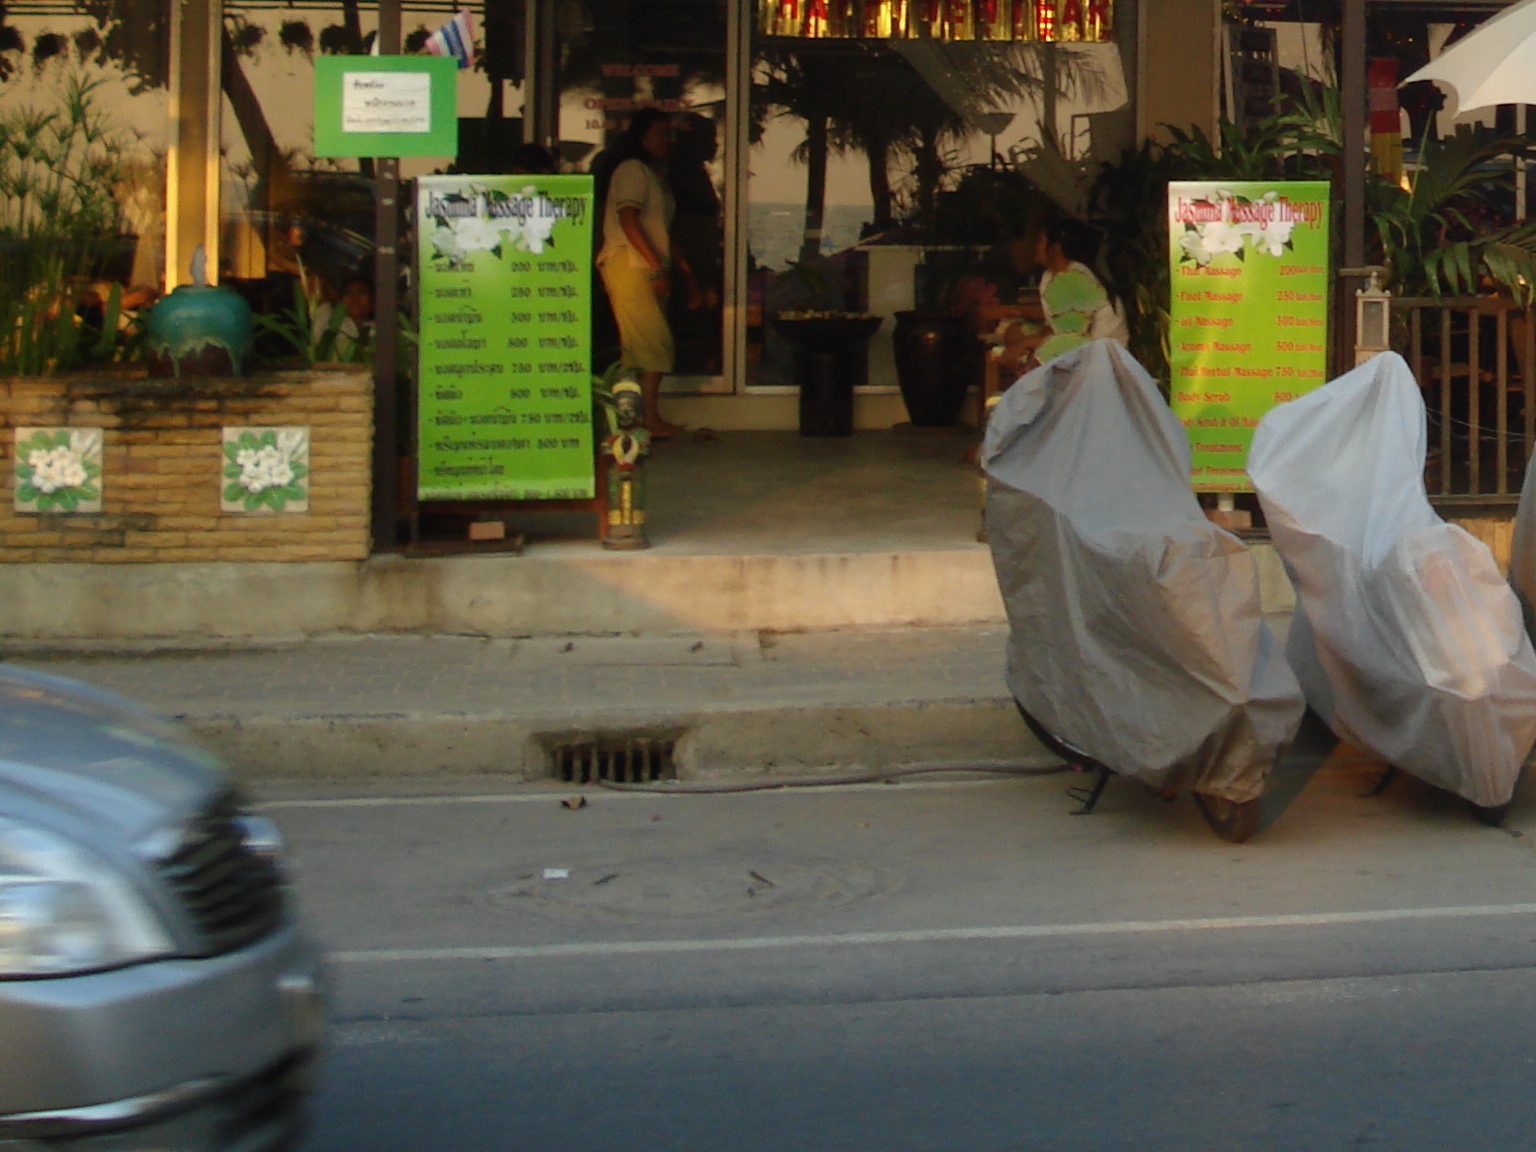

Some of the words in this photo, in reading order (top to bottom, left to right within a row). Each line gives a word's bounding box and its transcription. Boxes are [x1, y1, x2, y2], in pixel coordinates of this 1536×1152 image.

[425, 190, 477, 218] Jasmina
[481, 190, 533, 226] Massage
[540, 191, 586, 226] Therapy
[1175, 196, 1222, 223] Jasmina
[1226, 197, 1275, 231] Massage
[1279, 197, 1323, 230] Therapy
[1205, 266, 1242, 279] Massage
[1204, 291, 1243, 304] Massage
[1195, 316, 1234, 329] Massage
[1213, 341, 1251, 354] Massage
[1234, 366, 1273, 379] Massage
[1204, 391, 1230, 402] Scrub
